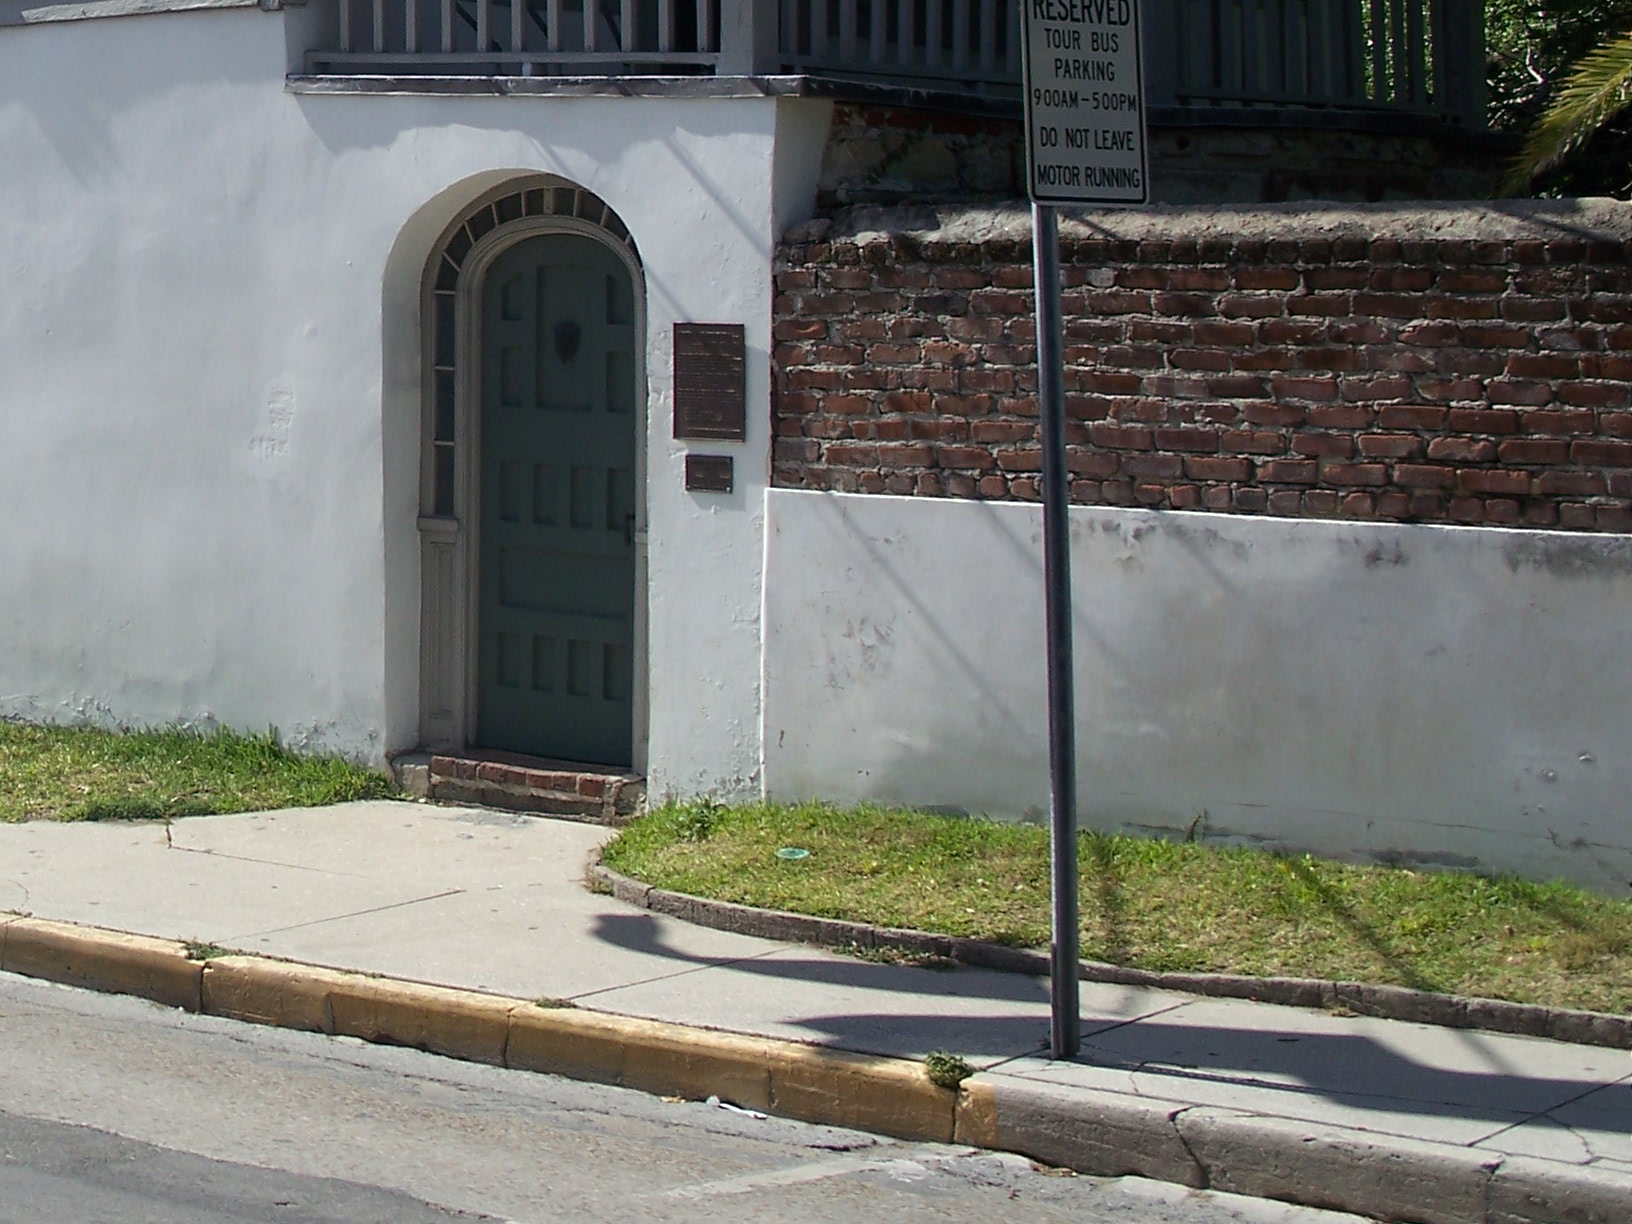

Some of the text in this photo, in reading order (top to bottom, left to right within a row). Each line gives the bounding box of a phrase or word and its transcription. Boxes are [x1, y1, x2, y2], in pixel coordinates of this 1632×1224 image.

[1045, 28, 1119, 53] TOUR BUS
[1054, 58, 1115, 82] PARKING
[1040, 126, 1135, 151] DO NOT LEAVE
[1037, 164, 1140, 189] MOTOR RUNNING
